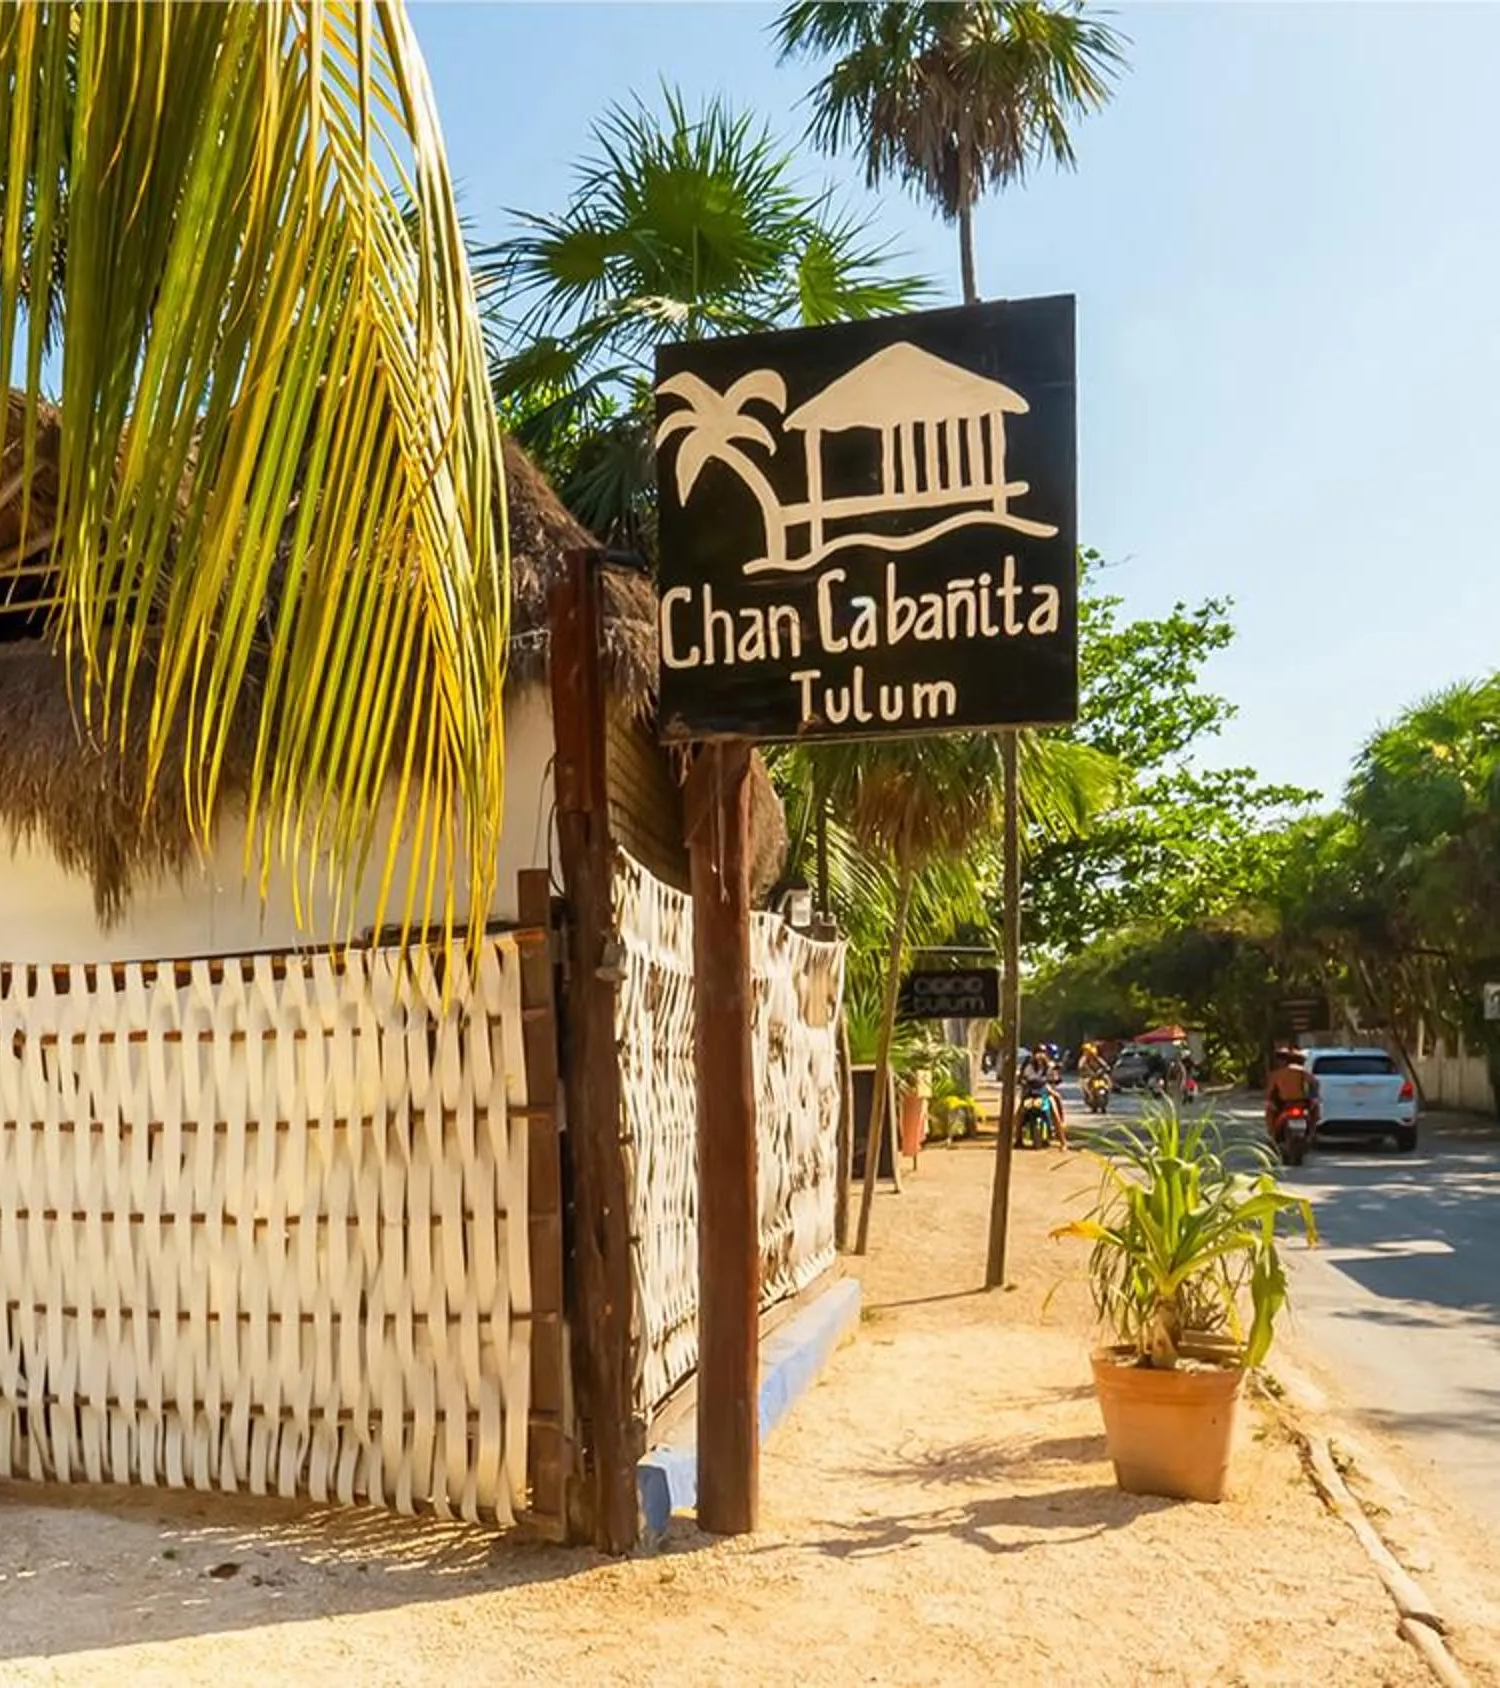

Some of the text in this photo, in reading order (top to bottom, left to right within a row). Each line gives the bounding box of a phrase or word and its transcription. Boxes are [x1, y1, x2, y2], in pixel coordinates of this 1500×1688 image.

[661, 556, 1060, 669] Chan Cabañita
[790, 666, 957, 724] Tulum
